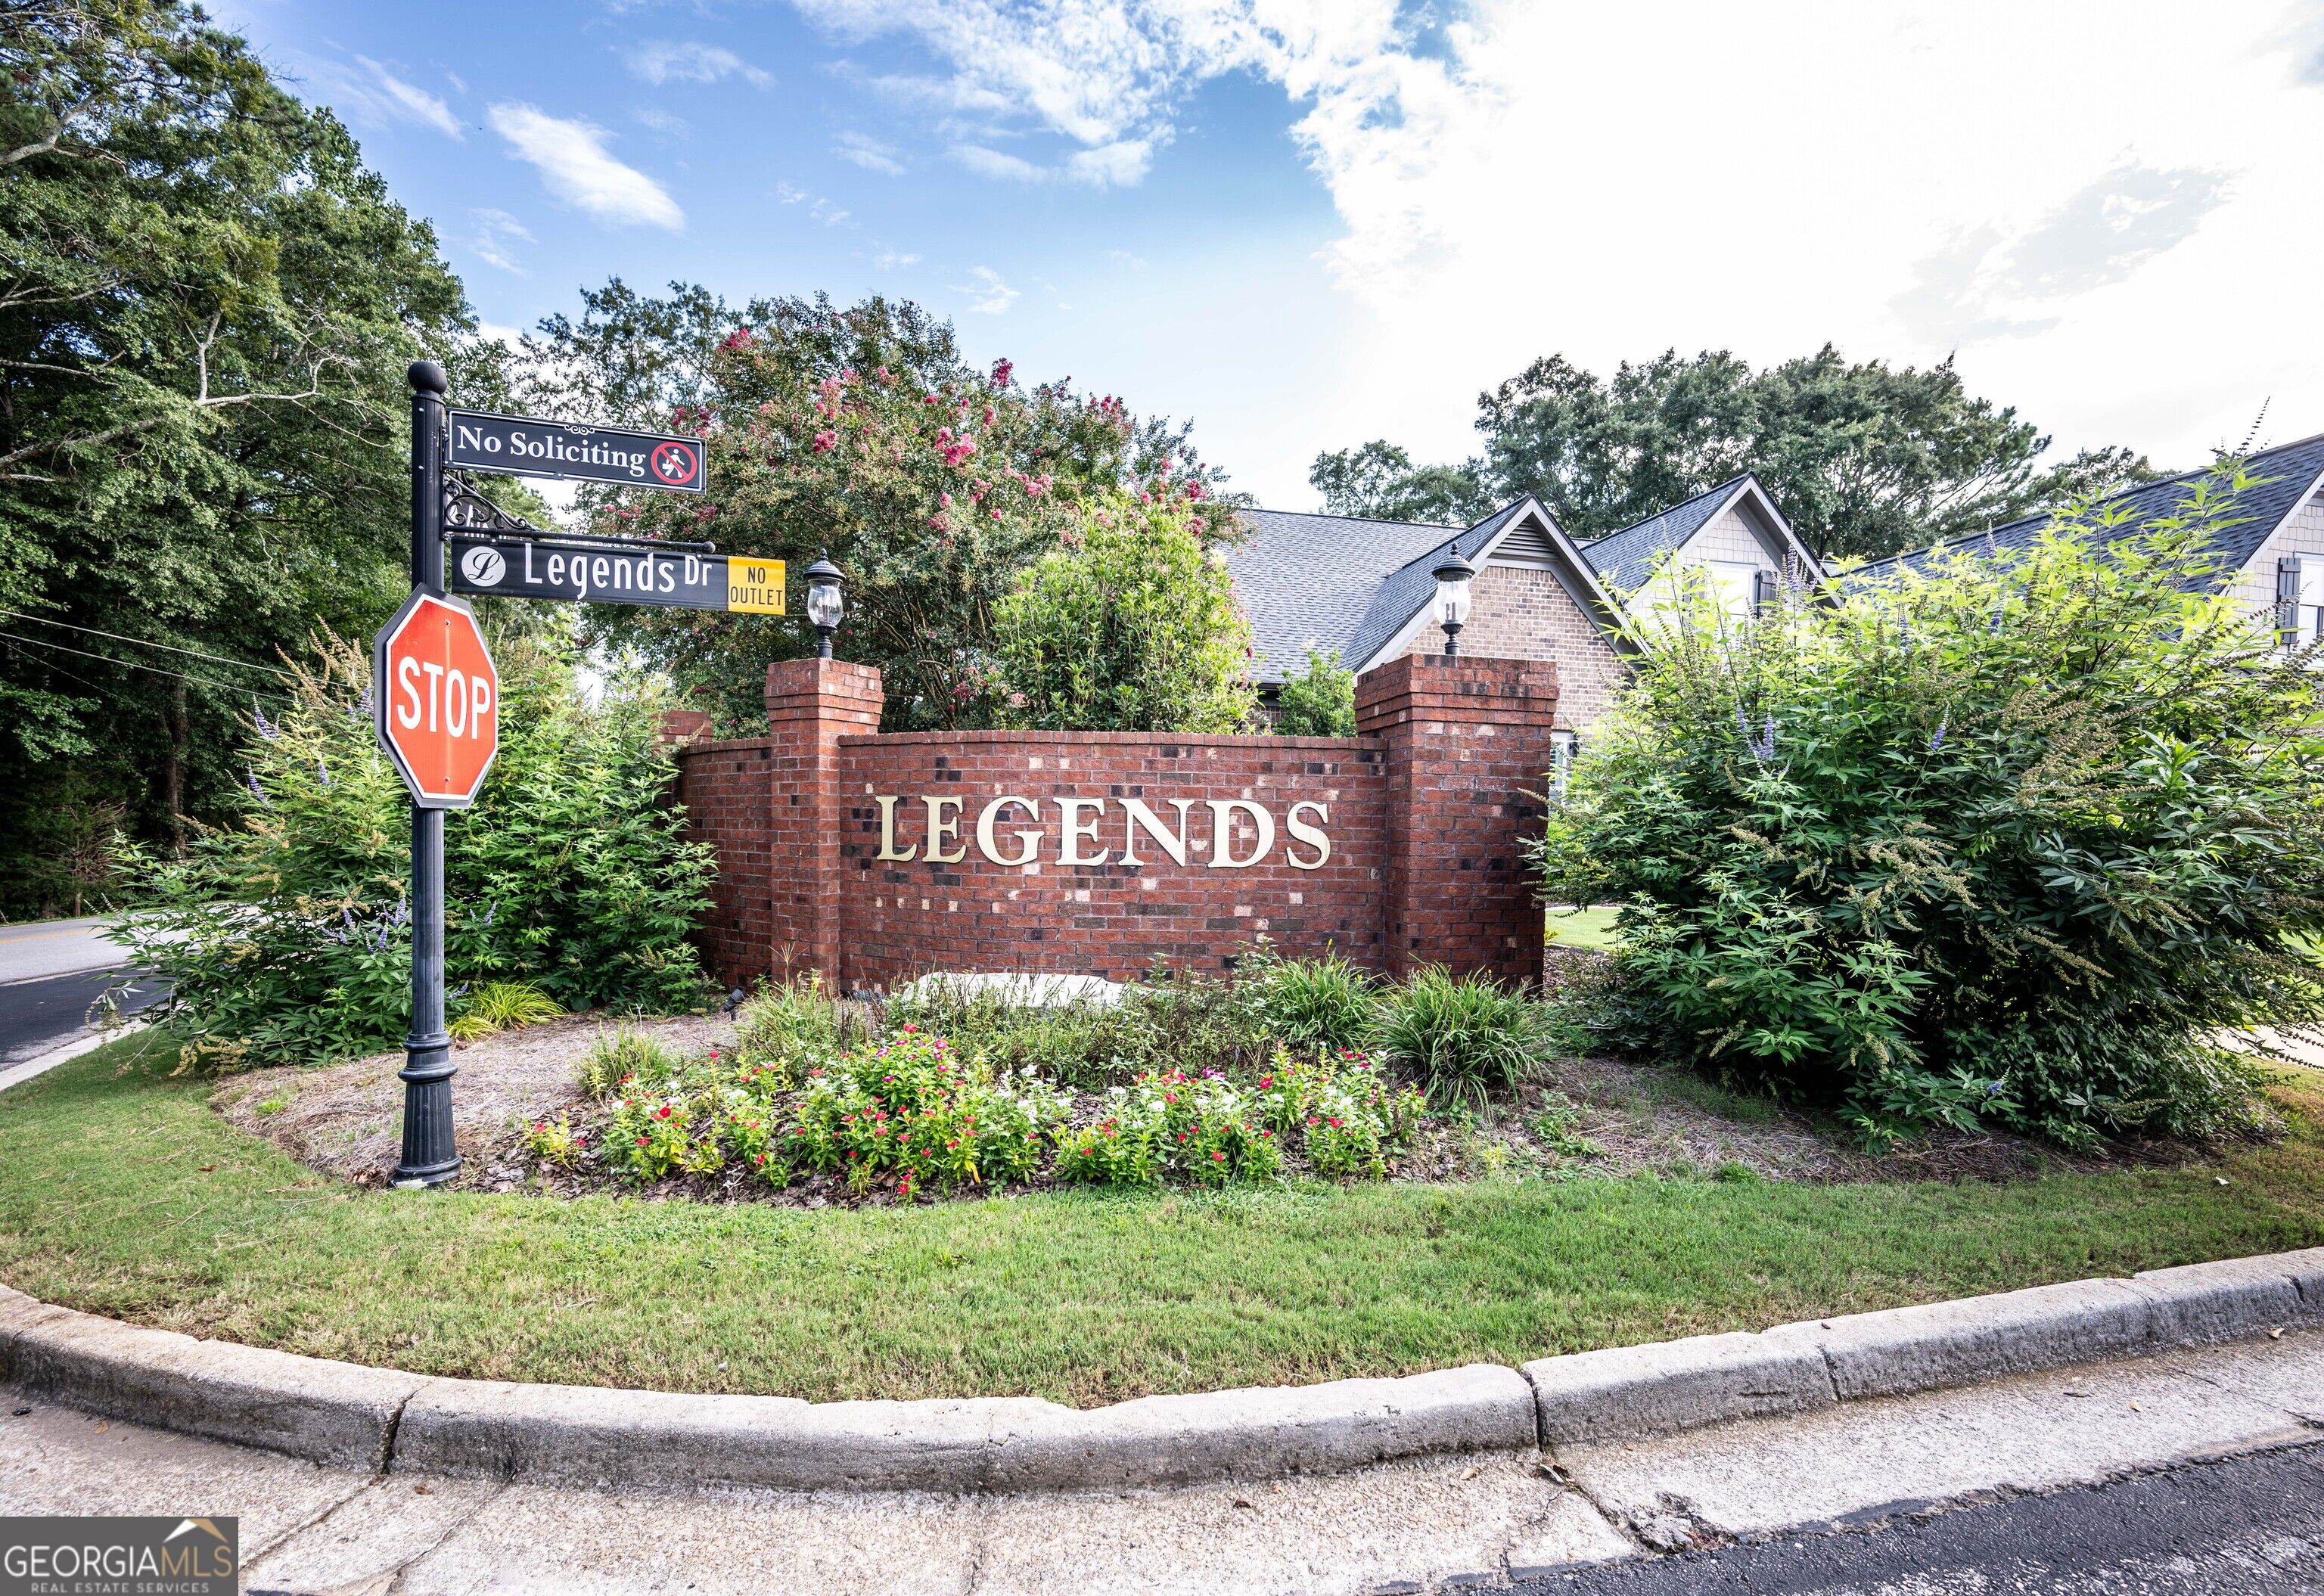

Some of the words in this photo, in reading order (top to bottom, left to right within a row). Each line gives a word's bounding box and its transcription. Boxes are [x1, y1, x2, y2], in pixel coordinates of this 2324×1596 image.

[457, 424, 501, 453] No
[510, 431, 646, 477] Soliciting
[525, 542, 675, 600] Legends
[685, 554, 712, 587] Dr
[730, 585, 782, 607] OUTLET
[747, 567, 766, 584] NO
[396, 656, 491, 740] STOP
[875, 795, 1331, 870] LEGENDS
